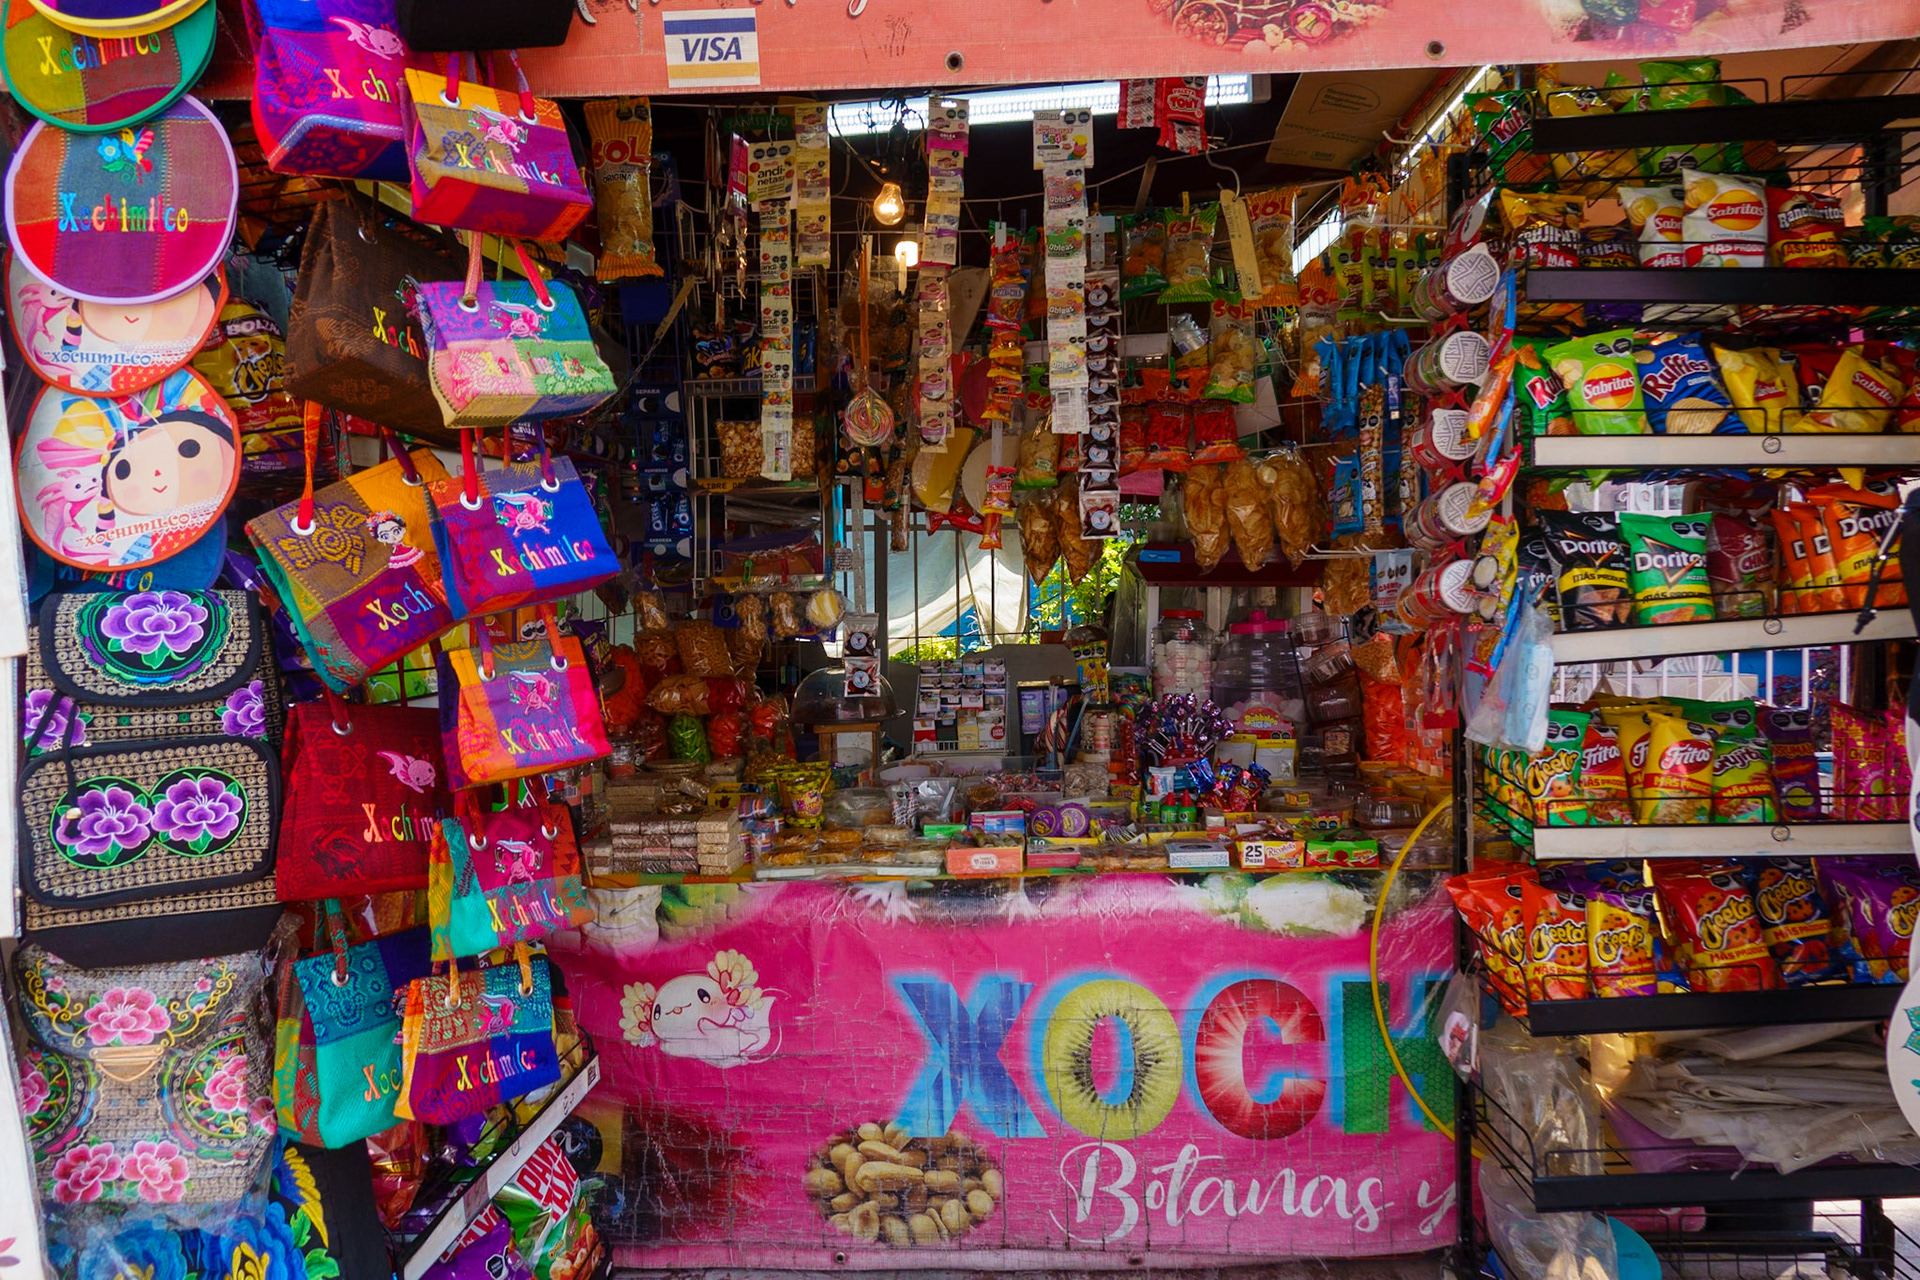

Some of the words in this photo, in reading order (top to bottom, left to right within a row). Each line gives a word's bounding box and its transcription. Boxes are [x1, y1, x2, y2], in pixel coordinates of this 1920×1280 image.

[681, 36, 742, 62] VISA
[455, 142, 562, 187] Xochimilco
[58, 192, 188, 232] Xochimilco
[1707, 204, 1765, 221] Sabritas
[1212, 298, 1254, 319] SOL
[1583, 376, 1635, 400] Sabritas
[1641, 354, 1711, 402] Ruffles
[490, 534, 595, 577] Xochimilco
[365, 579, 435, 626] Xoch
[1660, 743, 1712, 770] Fritos
[1245, 845, 1263, 857] 25
[488, 887, 570, 933] Xochimilco
[456, 1046, 536, 1092] Xochimilco
[1049, 1142, 1394, 1244] Botanas
[1417, 1180, 1457, 1235] y
